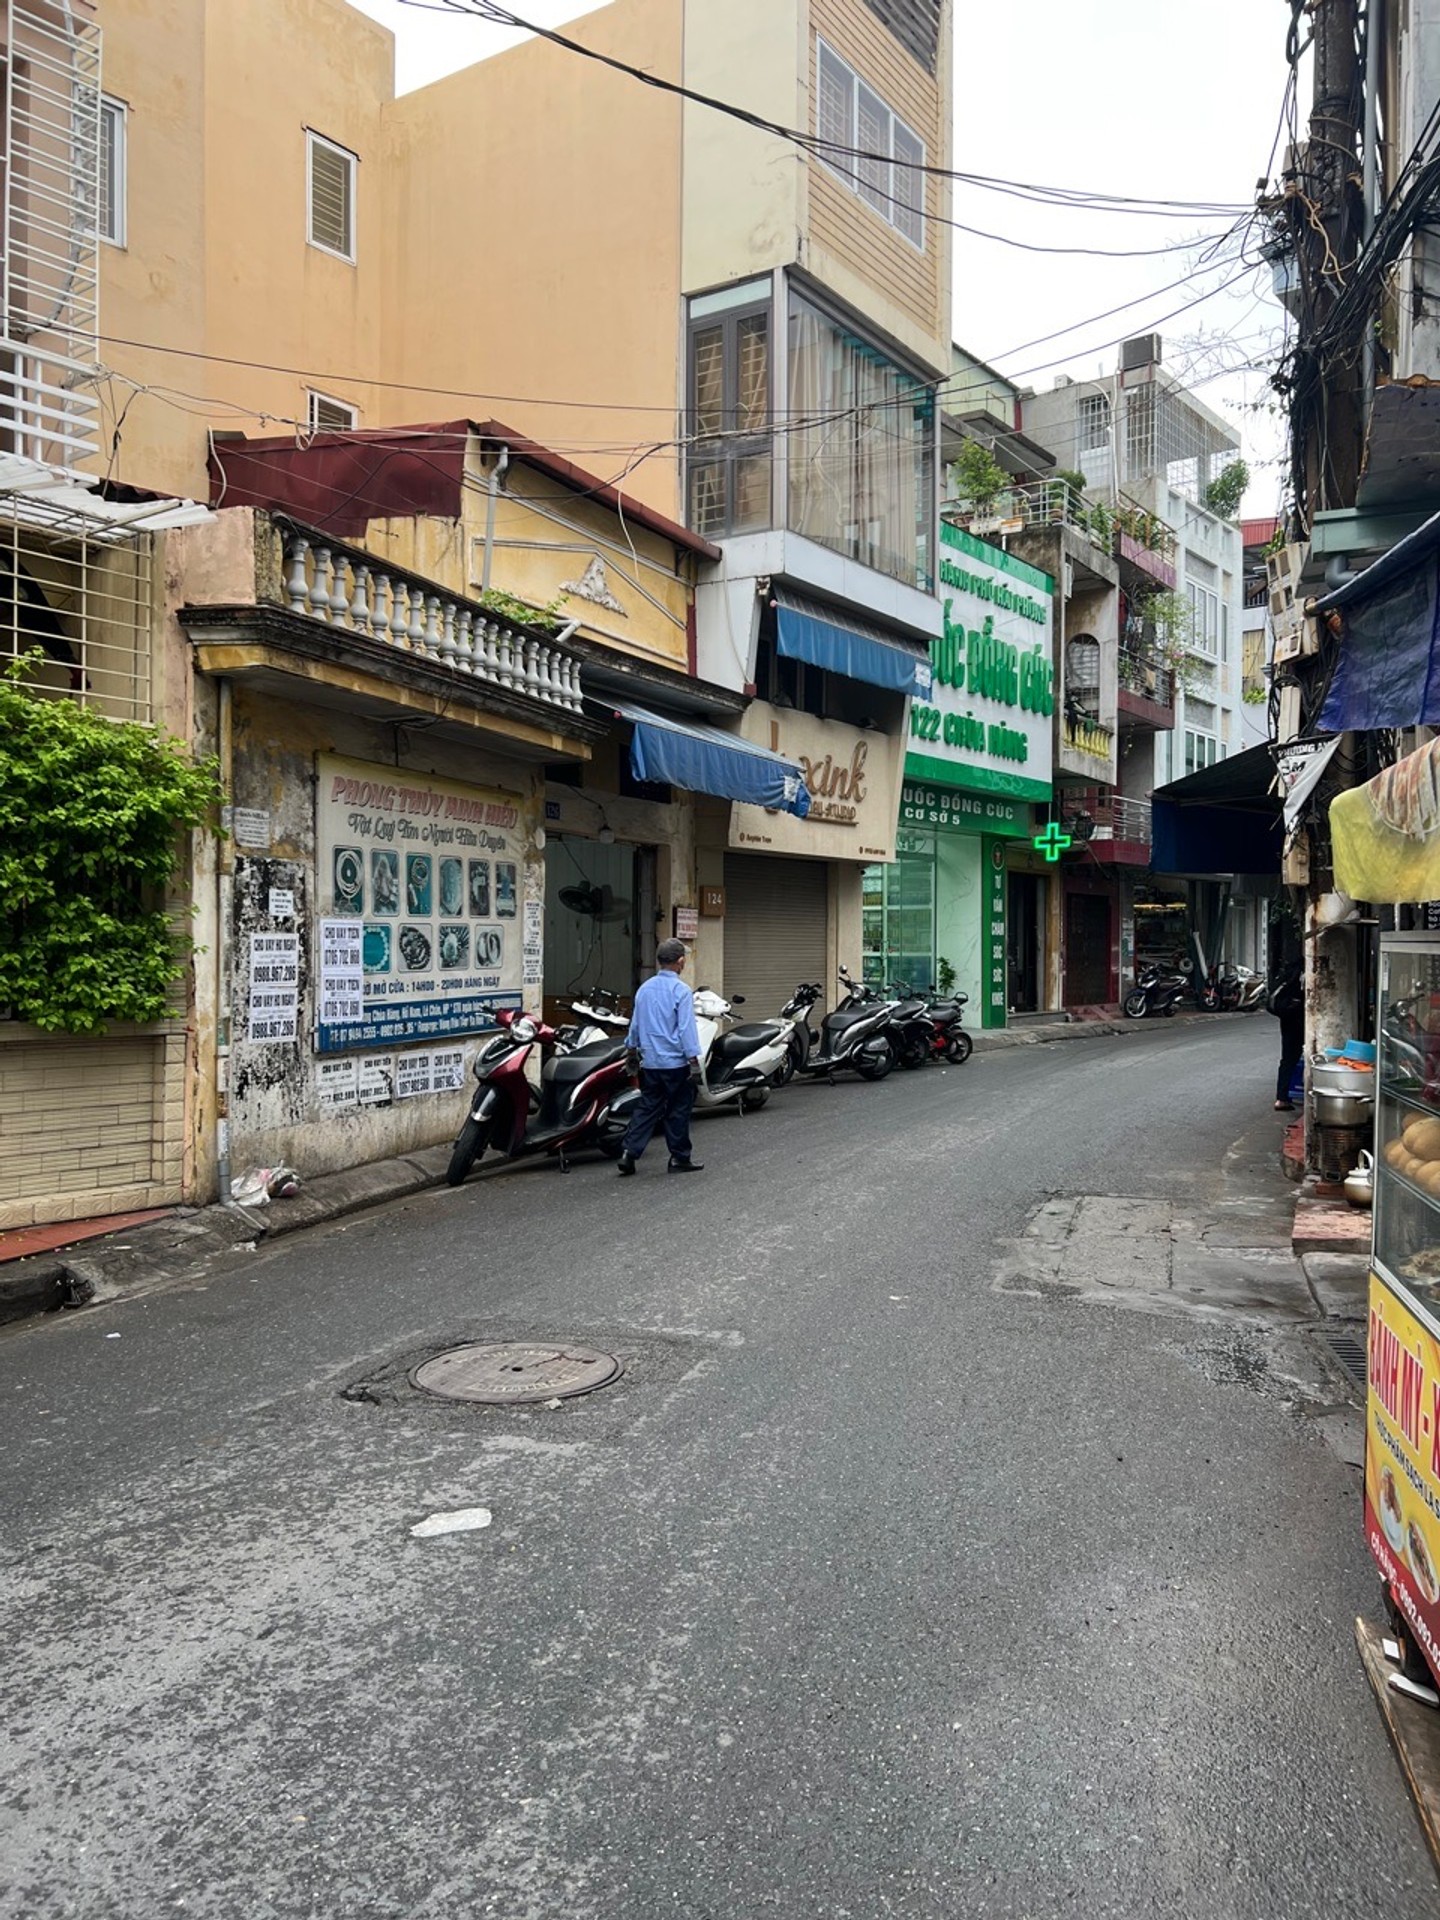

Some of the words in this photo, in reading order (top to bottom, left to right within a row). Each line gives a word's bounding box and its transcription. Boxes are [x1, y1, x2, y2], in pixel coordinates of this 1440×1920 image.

[911, 703, 941, 741] 122
[331, 776, 397, 811] PHONG
[952, 814, 960, 825] 5
[707, 892, 722, 905] 124
[1369, 1302, 1399, 1422] BÁNH
